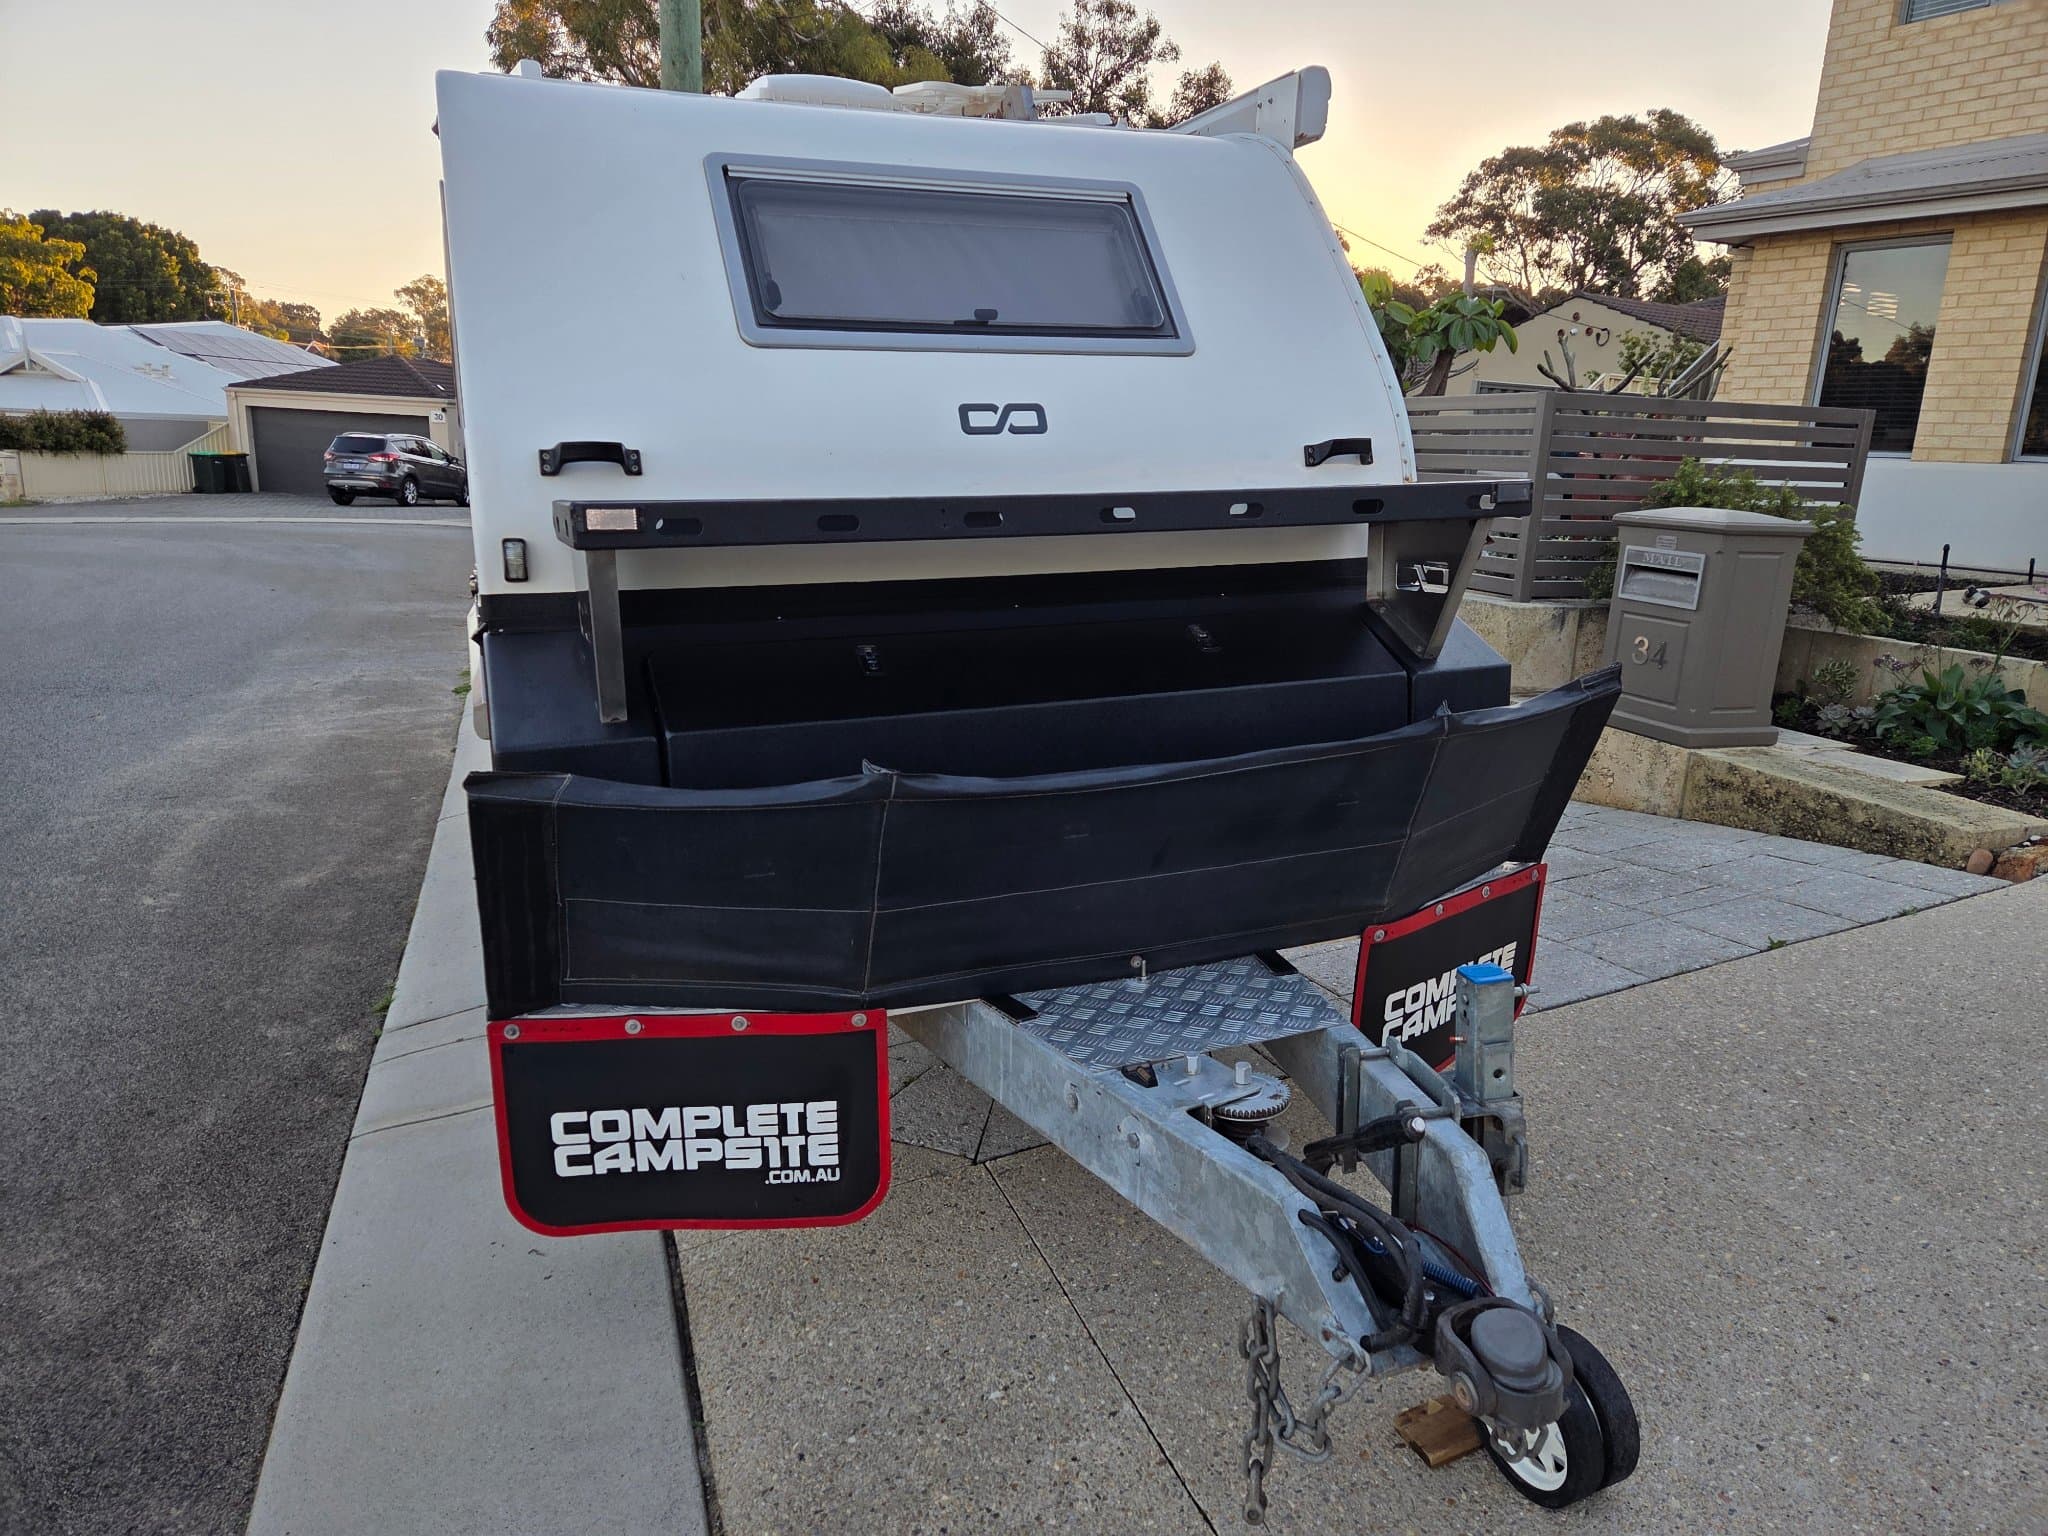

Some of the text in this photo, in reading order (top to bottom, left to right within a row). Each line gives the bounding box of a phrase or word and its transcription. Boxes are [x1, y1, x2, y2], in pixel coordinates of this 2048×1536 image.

[1642, 552, 1681, 567] MAIL
[1631, 635, 1667, 670] 34
[550, 1100, 838, 1145] COMPLETE
[765, 1167, 840, 1184] .COM.AU
